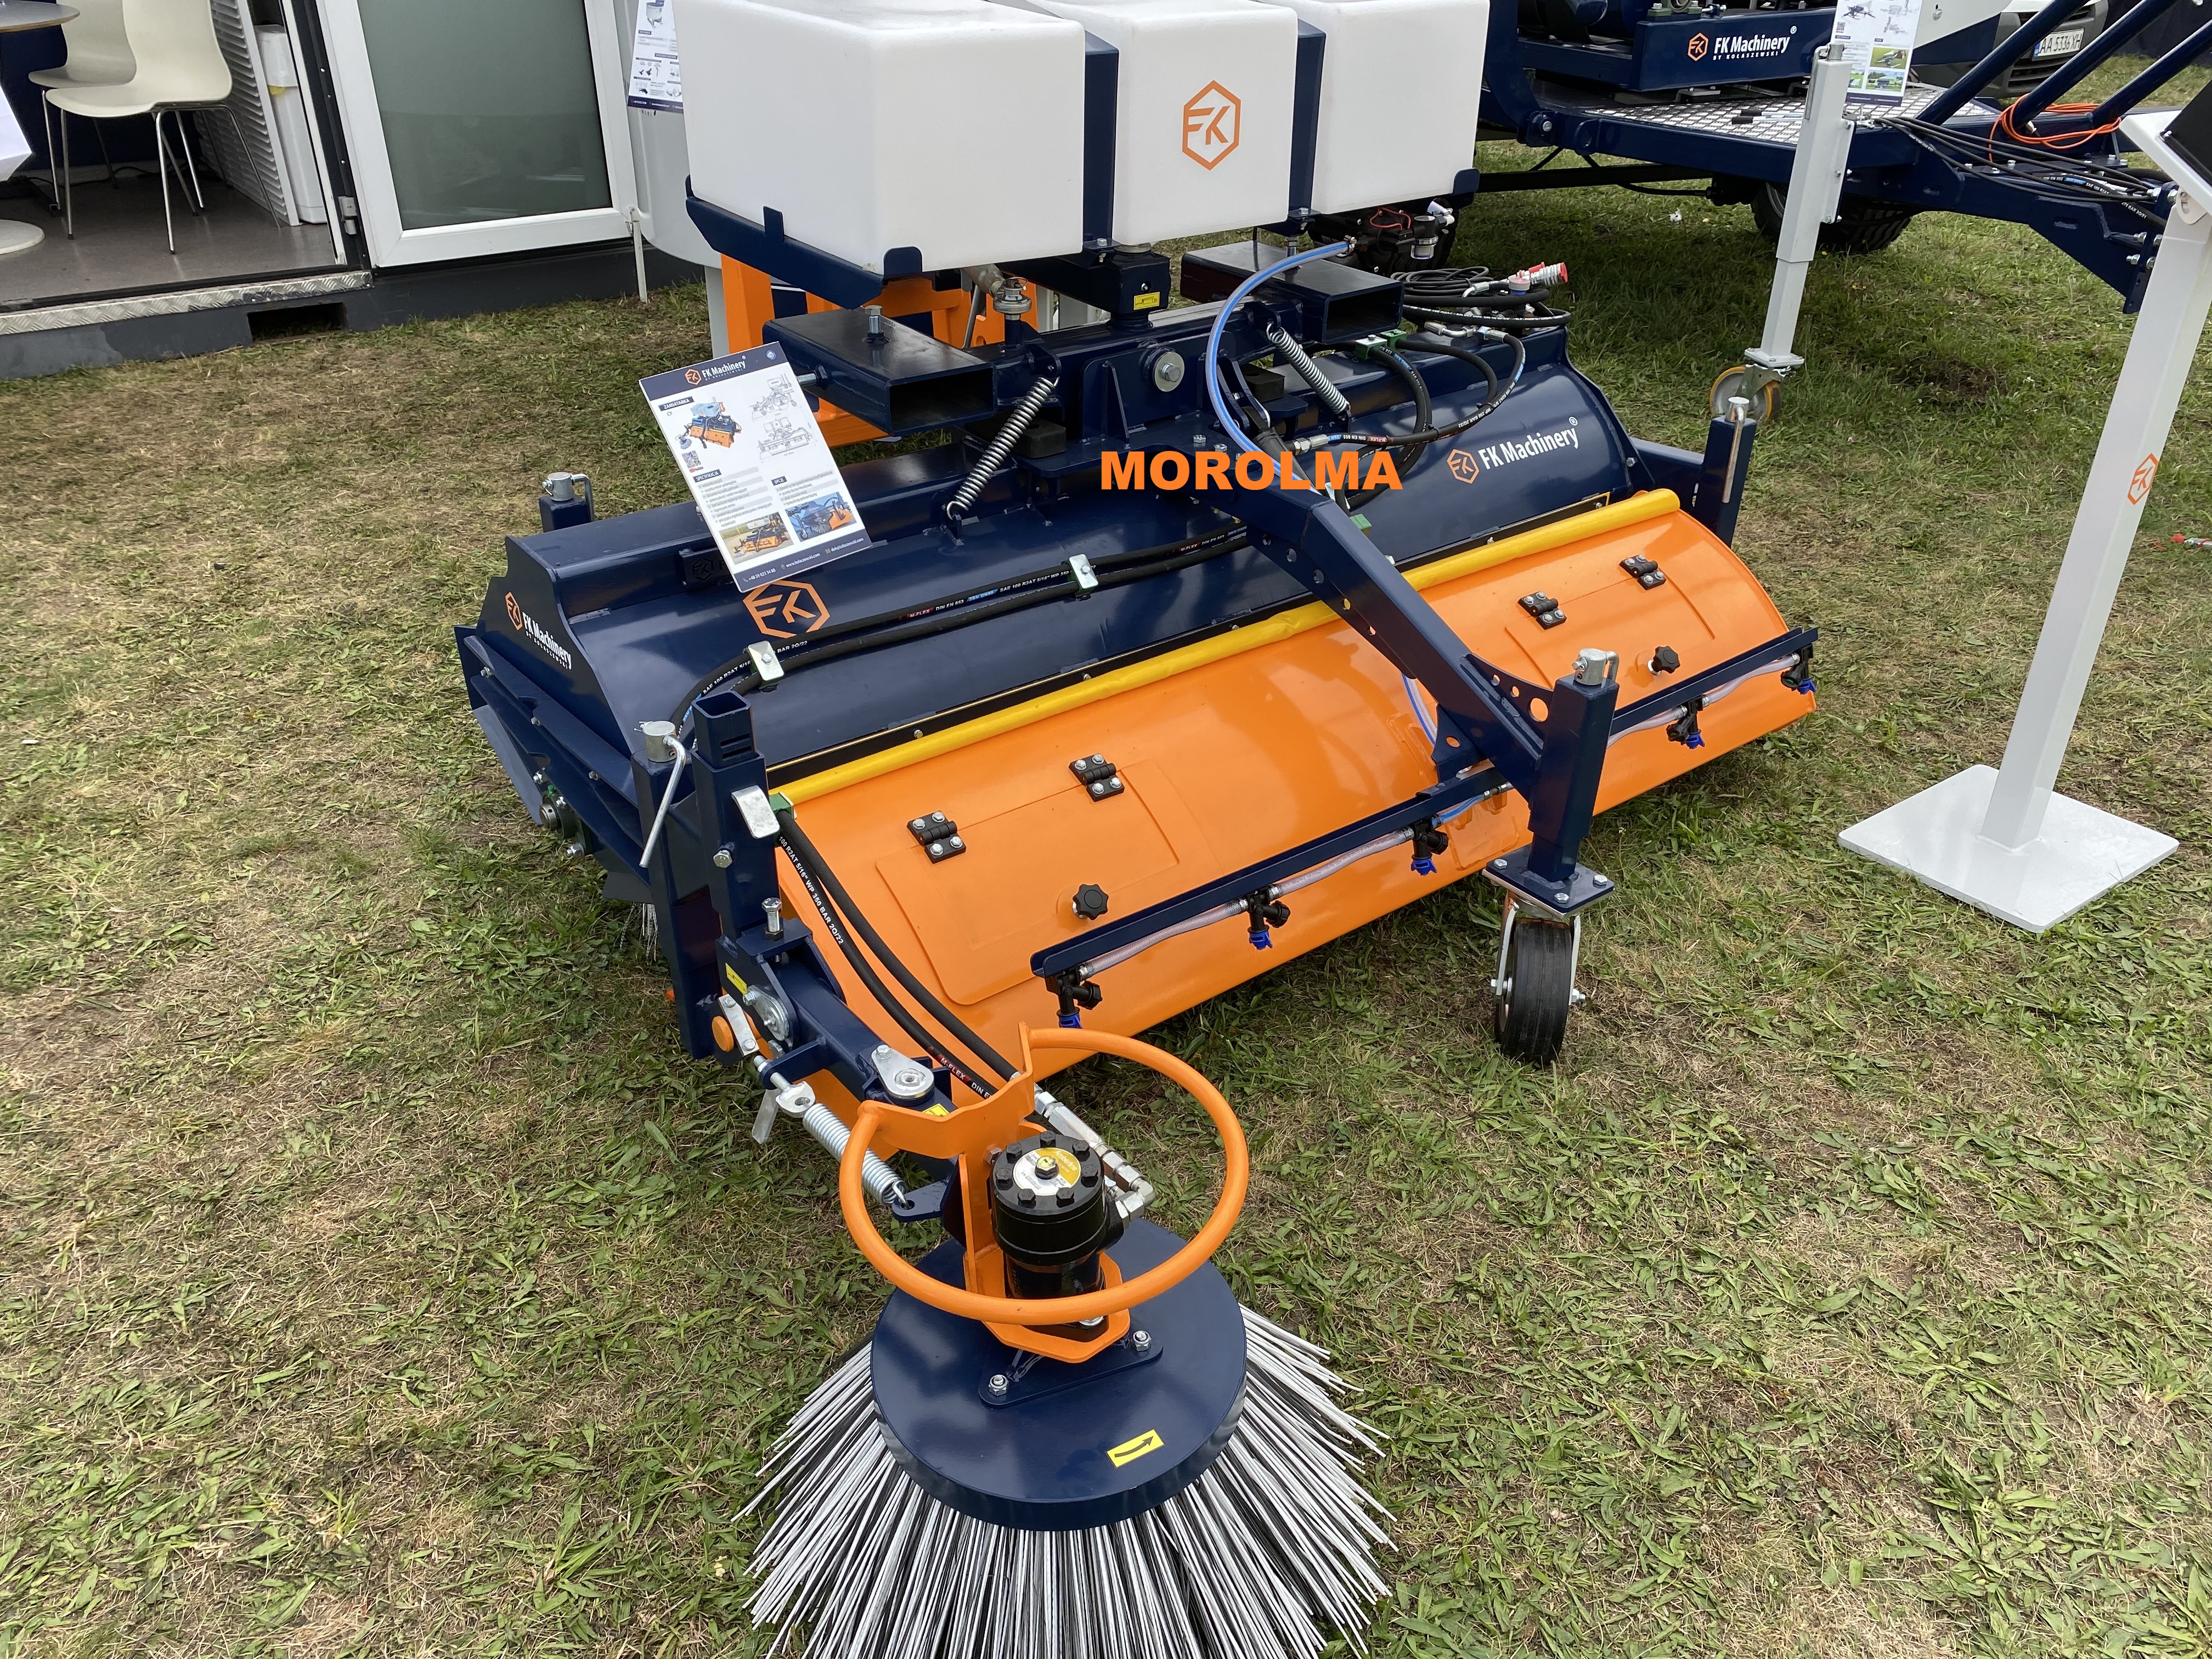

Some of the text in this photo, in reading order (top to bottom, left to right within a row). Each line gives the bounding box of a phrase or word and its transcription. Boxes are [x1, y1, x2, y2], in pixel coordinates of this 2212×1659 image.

[1714, 37, 1730, 54] FK
[1730, 34, 1790, 54] Machinery
[2040, 38, 2053, 53] AA
[2053, 36, 2070, 52] 5336
[701, 368, 713, 379] FK
[712, 360, 746, 376] Machinery
[1478, 445, 1504, 470] FK
[1499, 427, 1578, 464] Machinery
[522, 612, 572, 670] FK Machinery
[777, 645, 790, 653] BAR
[703, 683, 713, 695] SAE
[723, 666, 738, 679] R2AT
[779, 836, 788, 848] 100
[786, 845, 799, 863] R2AT
[805, 879, 815, 893] WP
[812, 893, 822, 906] 350
[820, 906, 832, 924] BAR
[829, 923, 844, 945] 2Q/22
[940, 1057, 966, 1080] M-FLEX
[971, 1082, 984, 1094] DIN
